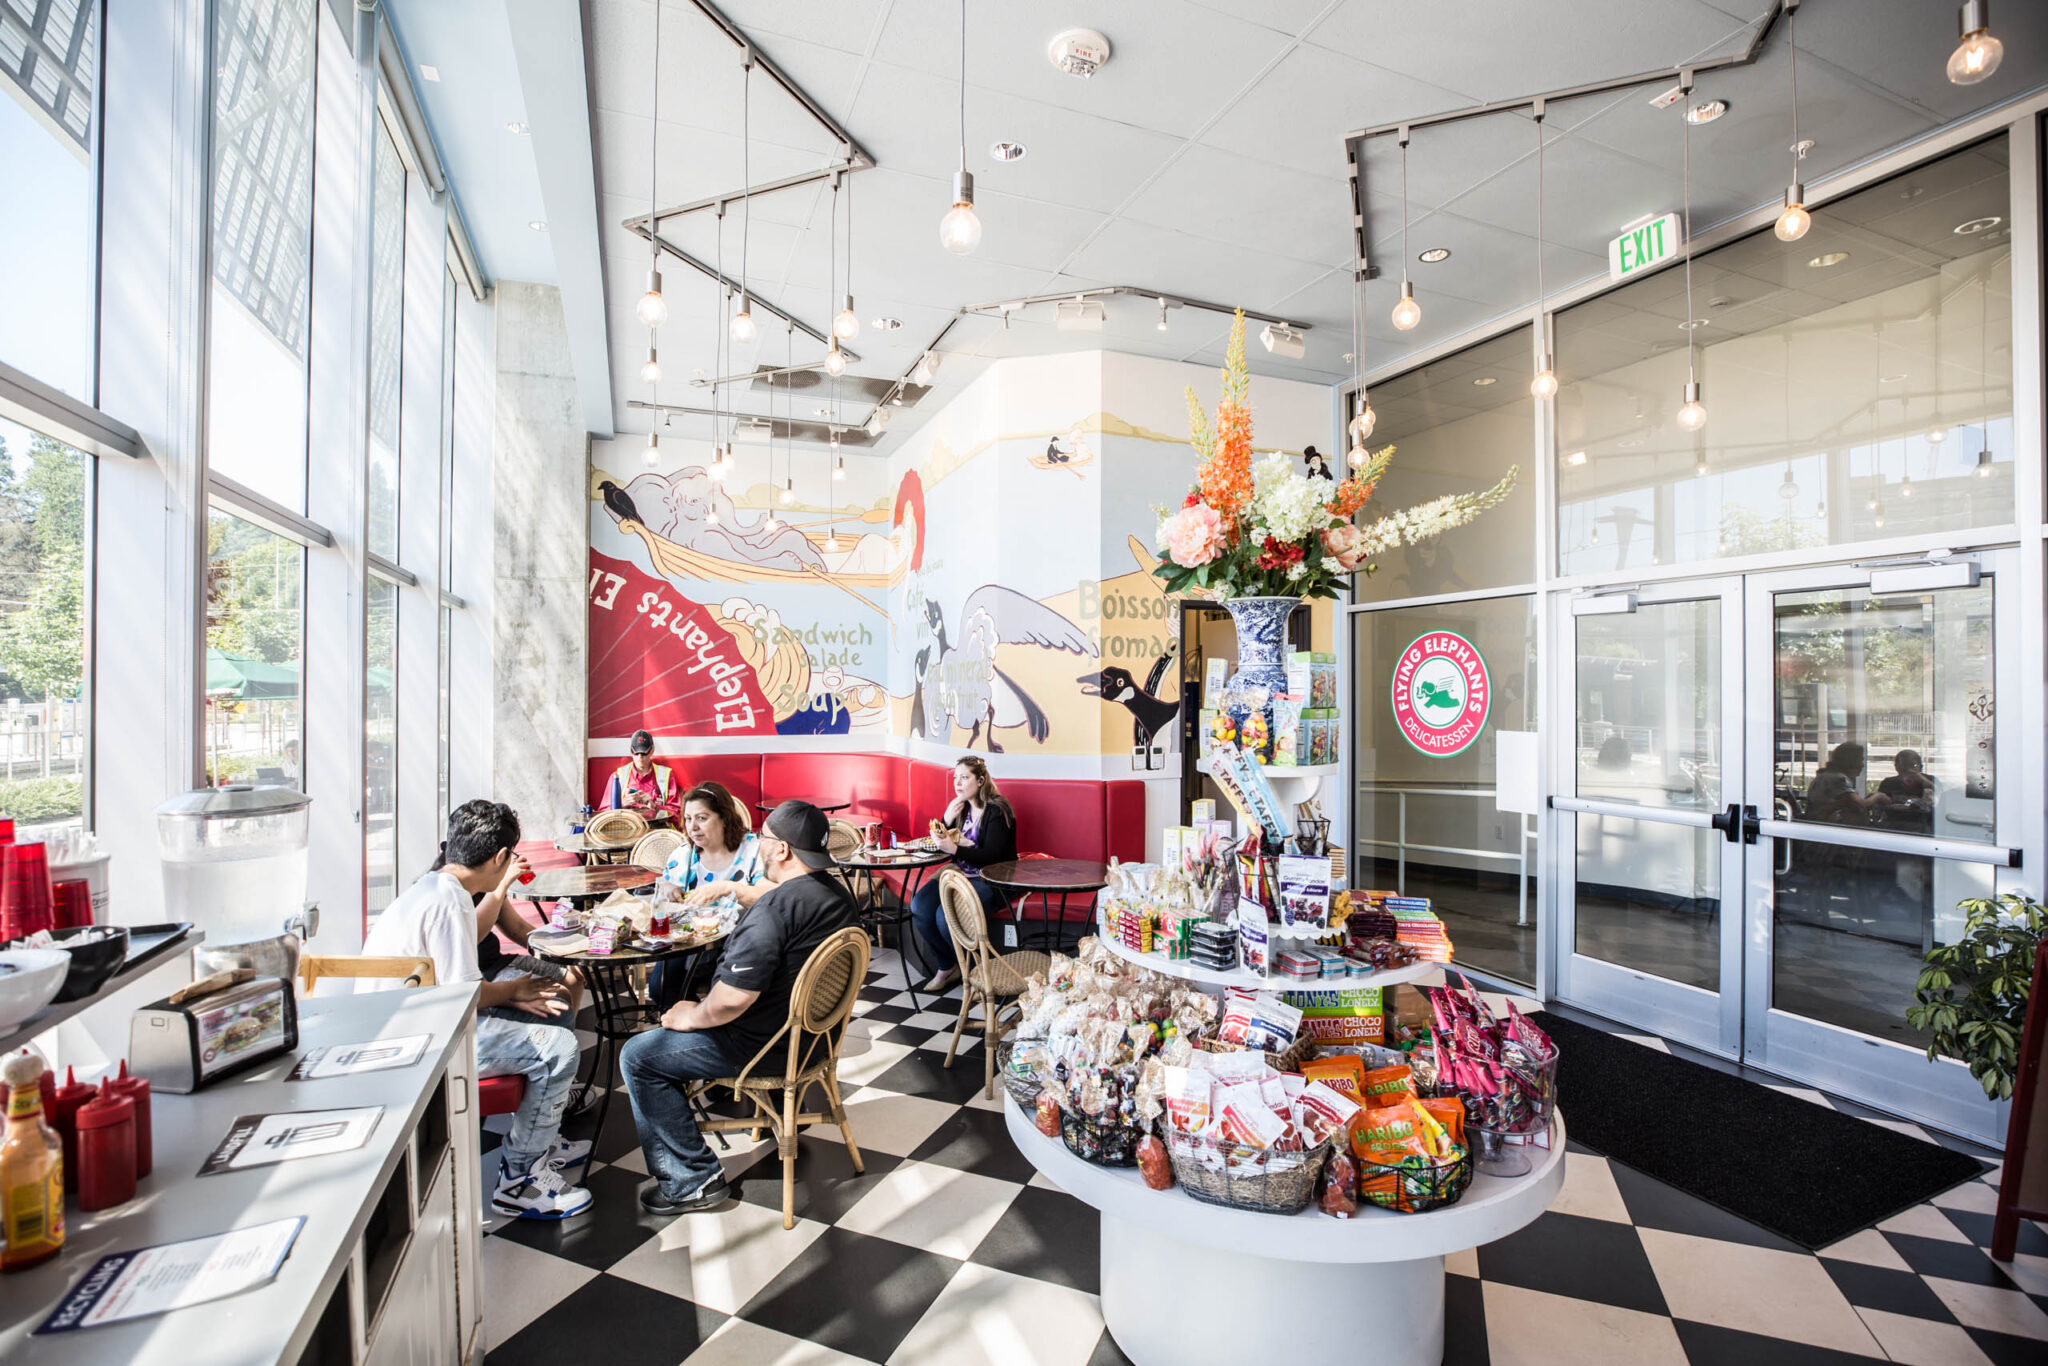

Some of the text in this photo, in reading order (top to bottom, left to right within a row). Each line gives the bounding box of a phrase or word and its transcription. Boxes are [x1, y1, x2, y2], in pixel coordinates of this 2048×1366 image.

[1619, 218, 1666, 274] EXIT
[1079, 579, 1180, 620] Boisson
[752, 618, 873, 645] Sandwich
[636, 591, 756, 733] Elephants
[800, 647, 863, 668] salade
[1396, 637, 1484, 714] FLYING ELEPHANTS
[777, 684, 845, 726] Soup
[1404, 717, 1475, 748] DELICATESSEN
[1219, 768, 1250, 806] TAFFY
[1254, 797, 1281, 840] TAFFY
[1341, 987, 1380, 997] CHOCO
[1344, 1016, 1382, 1027] CHOCO
[1355, 1123, 1415, 1145] HARIBO
[1370, 1141, 1408, 1153] FROGS
[51, 1256, 126, 1328] RECYCLING
